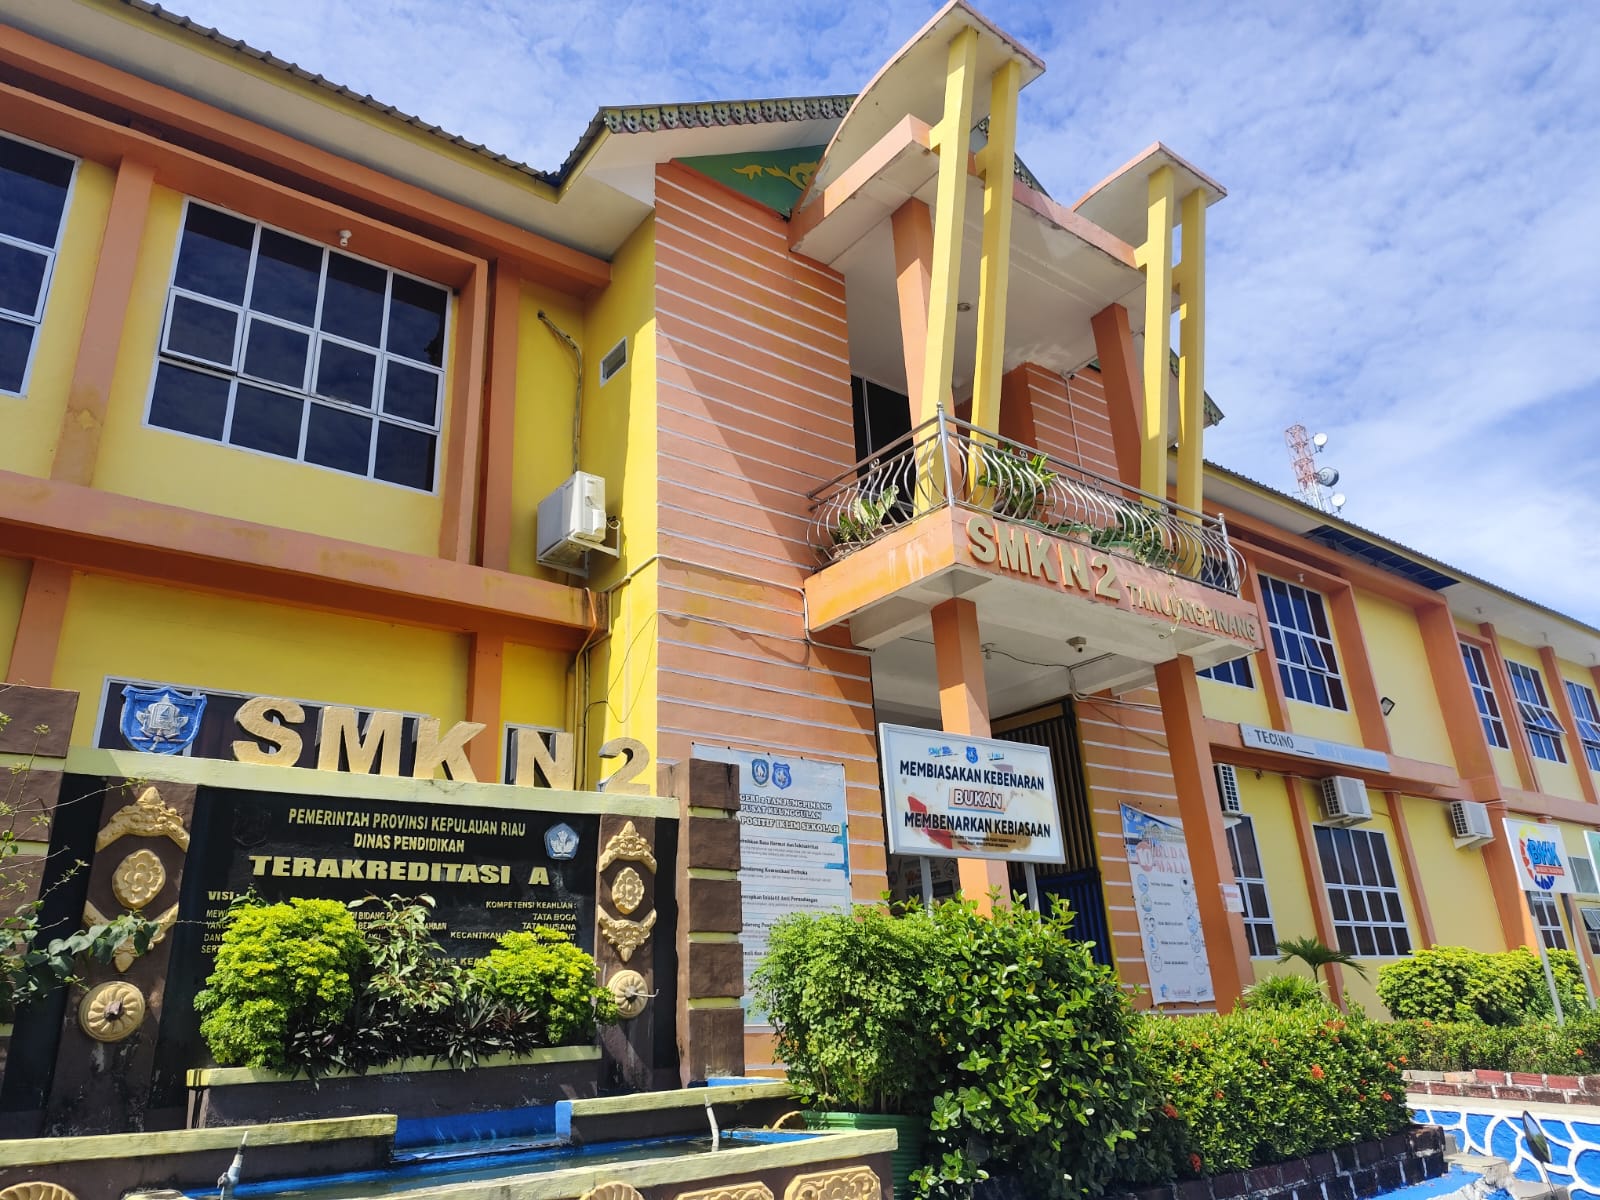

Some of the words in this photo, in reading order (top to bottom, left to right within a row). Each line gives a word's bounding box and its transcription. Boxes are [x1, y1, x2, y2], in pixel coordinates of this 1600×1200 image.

[966, 515, 1059, 584] SMK
[1056, 542, 1091, 592] N
[1090, 556, 1121, 601] 2
[1125, 581, 1256, 642] TANJUNGPINANG
[232, 696, 487, 783] SMK
[514, 730, 574, 791] N
[597, 736, 650, 796] 2
[899, 759, 981, 783] MEMBIASAKAN
[983, 769, 1045, 791] KEBENARAN
[766, 796, 832, 811] TANJUNGPINANG
[953, 788, 1003, 809] BUKAN
[289, 808, 370, 828] PEMERINTAH
[372, 812, 429, 830] PROVINSI
[431, 816, 498, 836] KEPULAUAN
[500, 821, 526, 837] RIAU
[740, 804, 767, 814] PUSAT
[767, 806, 822, 820] KEUNGGULAN
[740, 816, 775, 828] POSITIF
[776, 819, 801, 831] IKLIM
[801, 822, 840, 834] SEKOLAH
[904, 811, 992, 834] MEMBENARKAN
[994, 819, 1051, 838] KEBIASAAN
[353, 832, 391, 850] DINAS
[393, 836, 465, 853] PENDIDIKAN
[249, 855, 511, 884] TERAKREDITASI
[528, 866, 550, 886] A
[358, 911, 386, 920] BIDANG
[486, 901, 535, 909] KOMPETENSI
[532, 913, 552, 921] TATA
[554, 913, 577, 921] BOGA
[450, 931, 501, 940] KECANTIKAN
